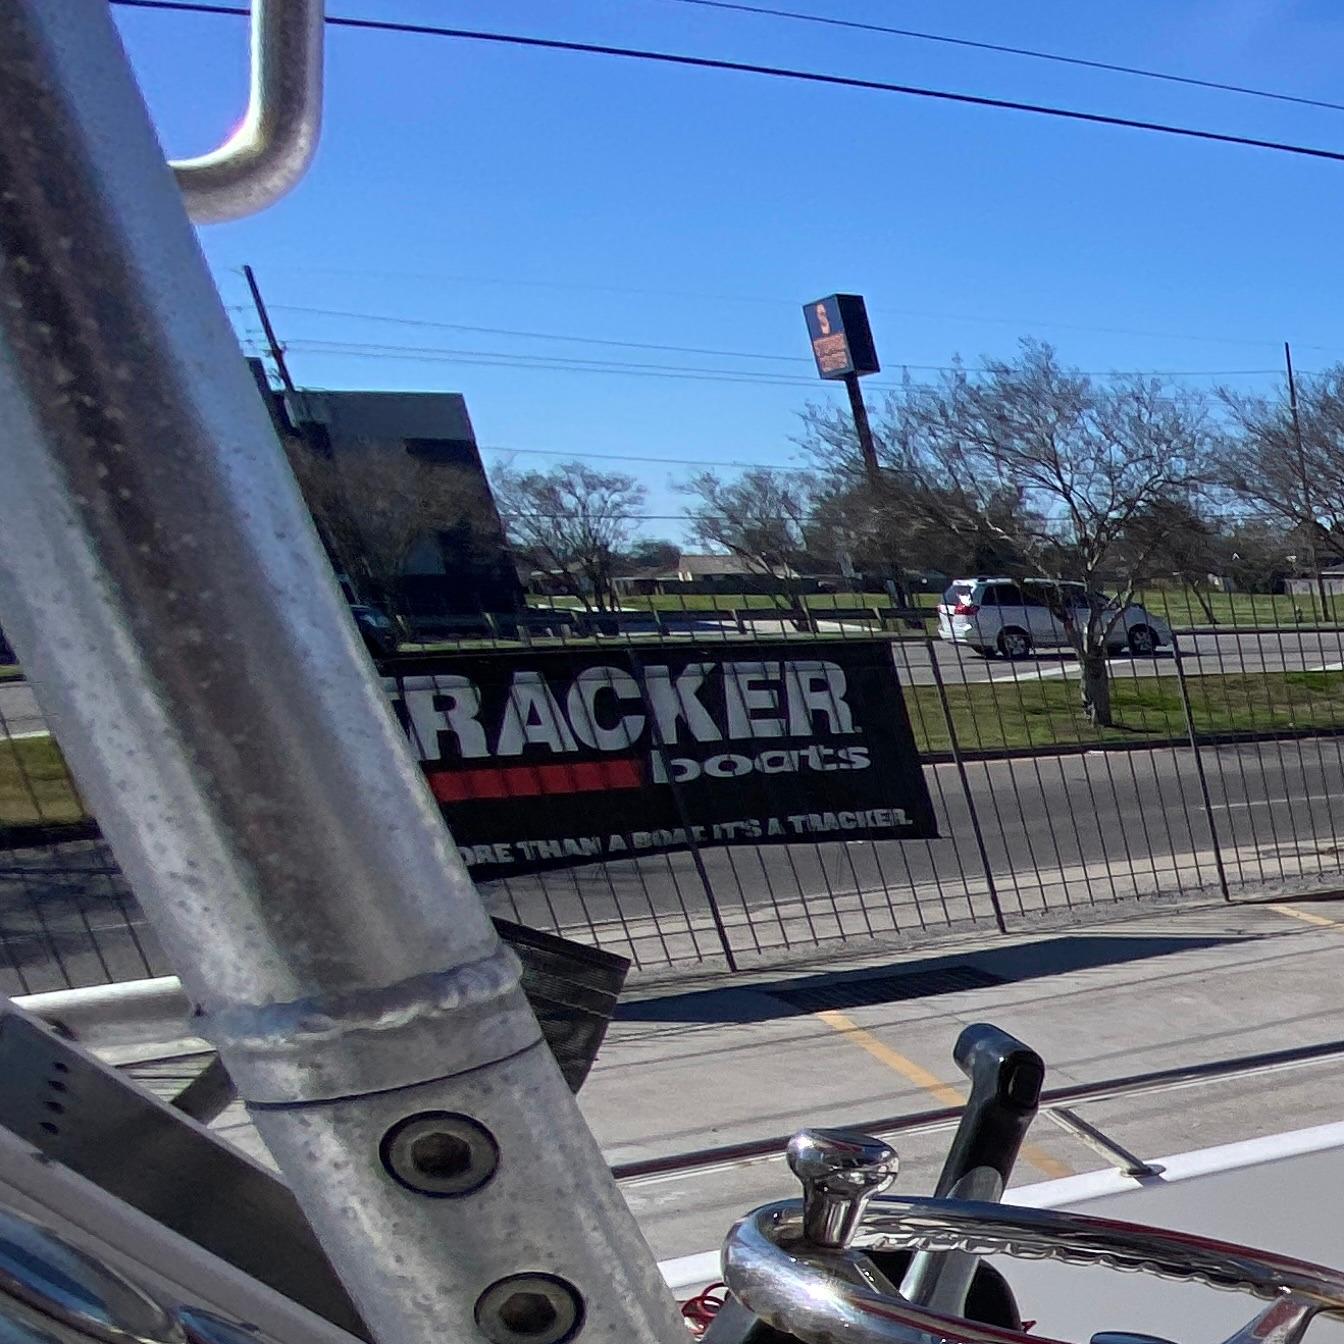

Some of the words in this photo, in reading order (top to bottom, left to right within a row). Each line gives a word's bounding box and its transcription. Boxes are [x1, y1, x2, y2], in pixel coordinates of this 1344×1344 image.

[651, 745, 872, 784] boats
[456, 842, 515, 866] ORE
[515, 838, 604, 862] THAN
[608, 834, 628, 852] A
[713, 818, 763, 840] IT'S
[767, 817, 786, 836] A
